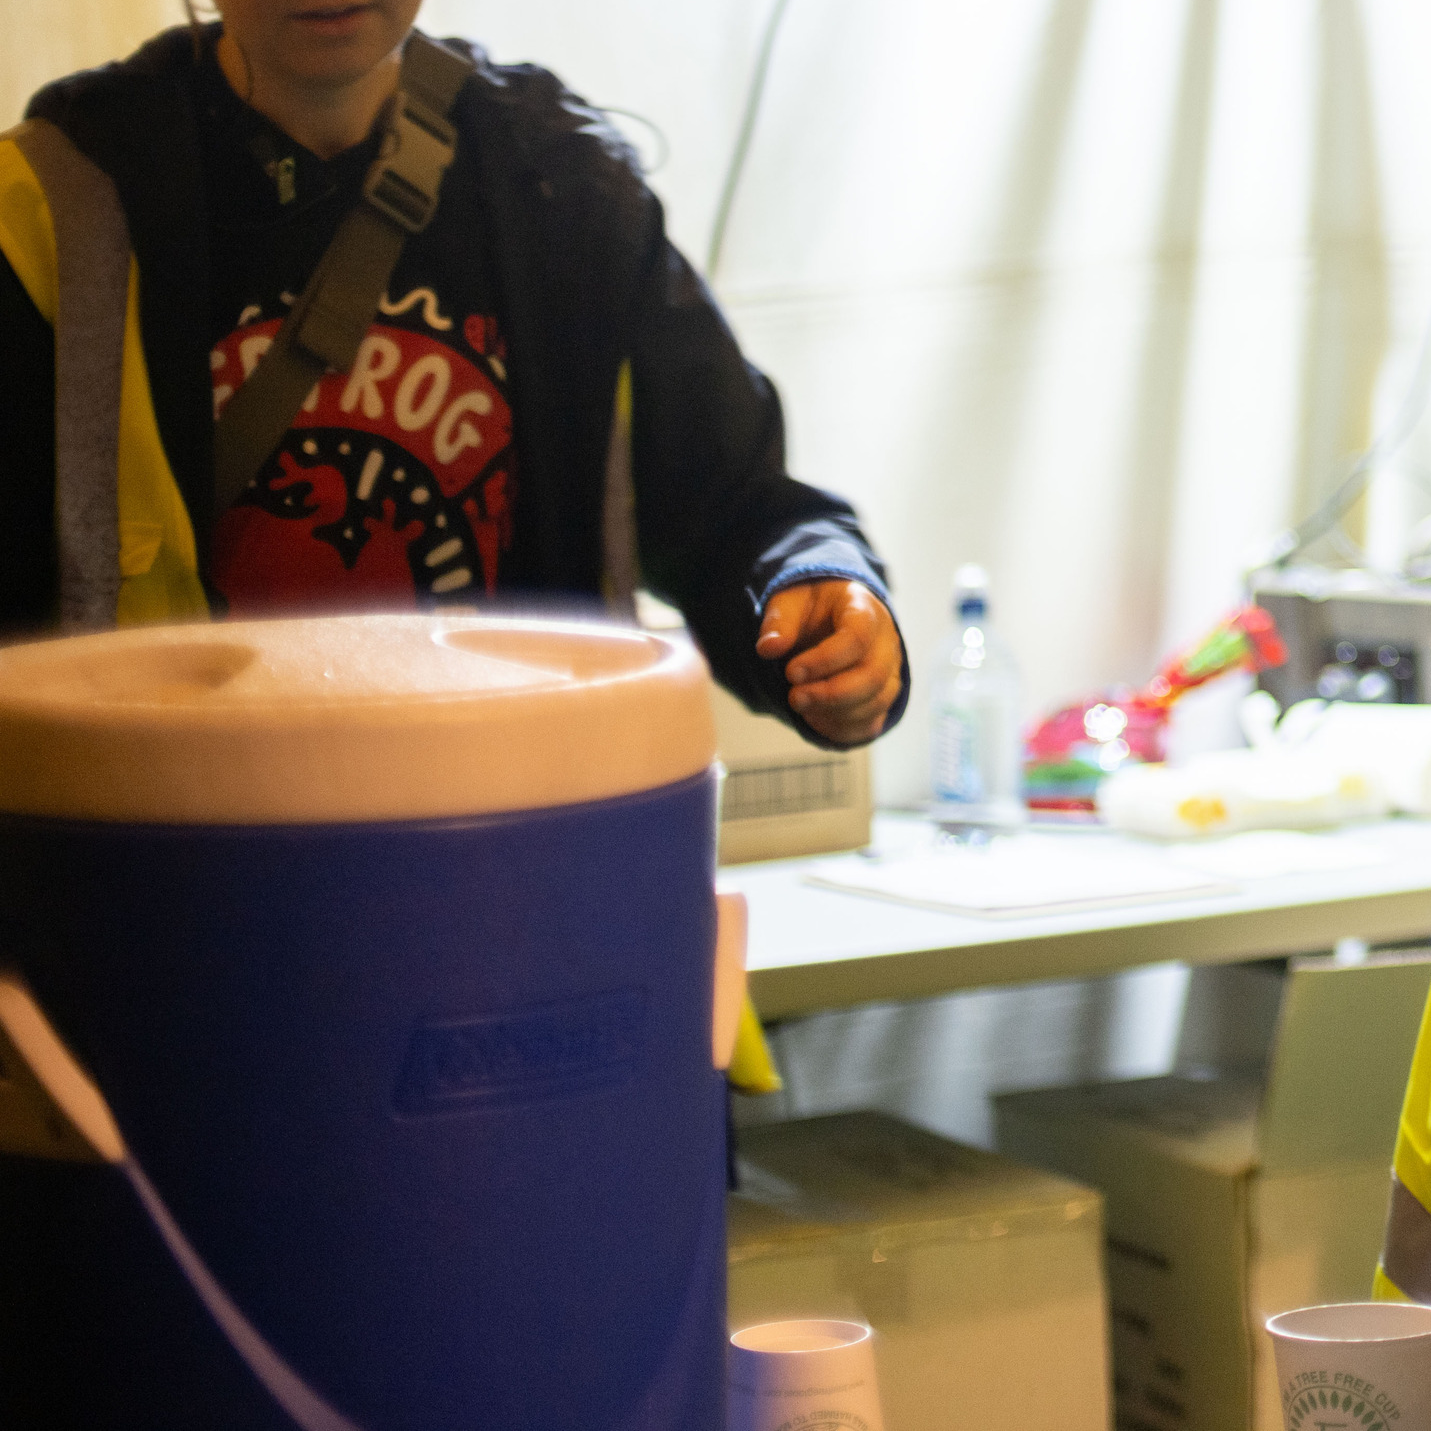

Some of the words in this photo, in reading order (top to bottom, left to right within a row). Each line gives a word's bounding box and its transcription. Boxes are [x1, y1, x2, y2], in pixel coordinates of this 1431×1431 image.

[1295, 1370, 1329, 1388] TREE
[1333, 1371, 1376, 1398] FREE
[1373, 1391, 1401, 1421] CUP
